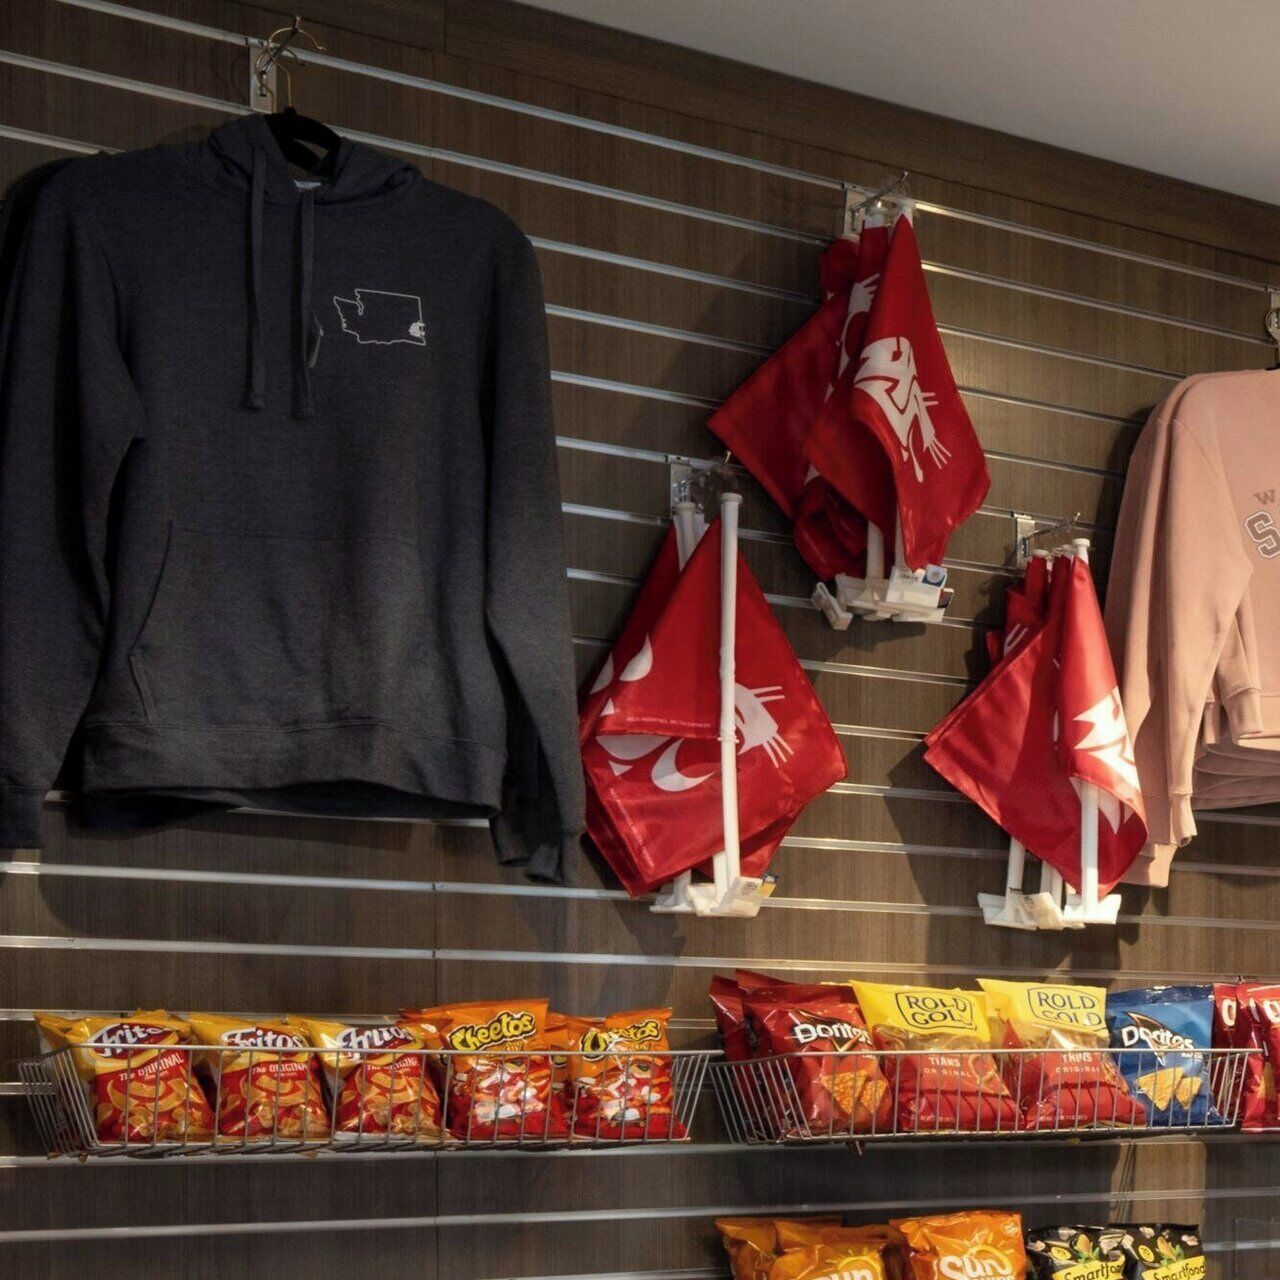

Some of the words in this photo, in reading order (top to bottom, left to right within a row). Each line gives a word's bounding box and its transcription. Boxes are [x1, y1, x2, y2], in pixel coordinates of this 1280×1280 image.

[905, 994, 968, 1012] ROLD
[1037, 991, 1096, 1010] ROLD
[449, 1011, 536, 1052] Cheetos
[1121, 1026, 1195, 1049] Doritos
